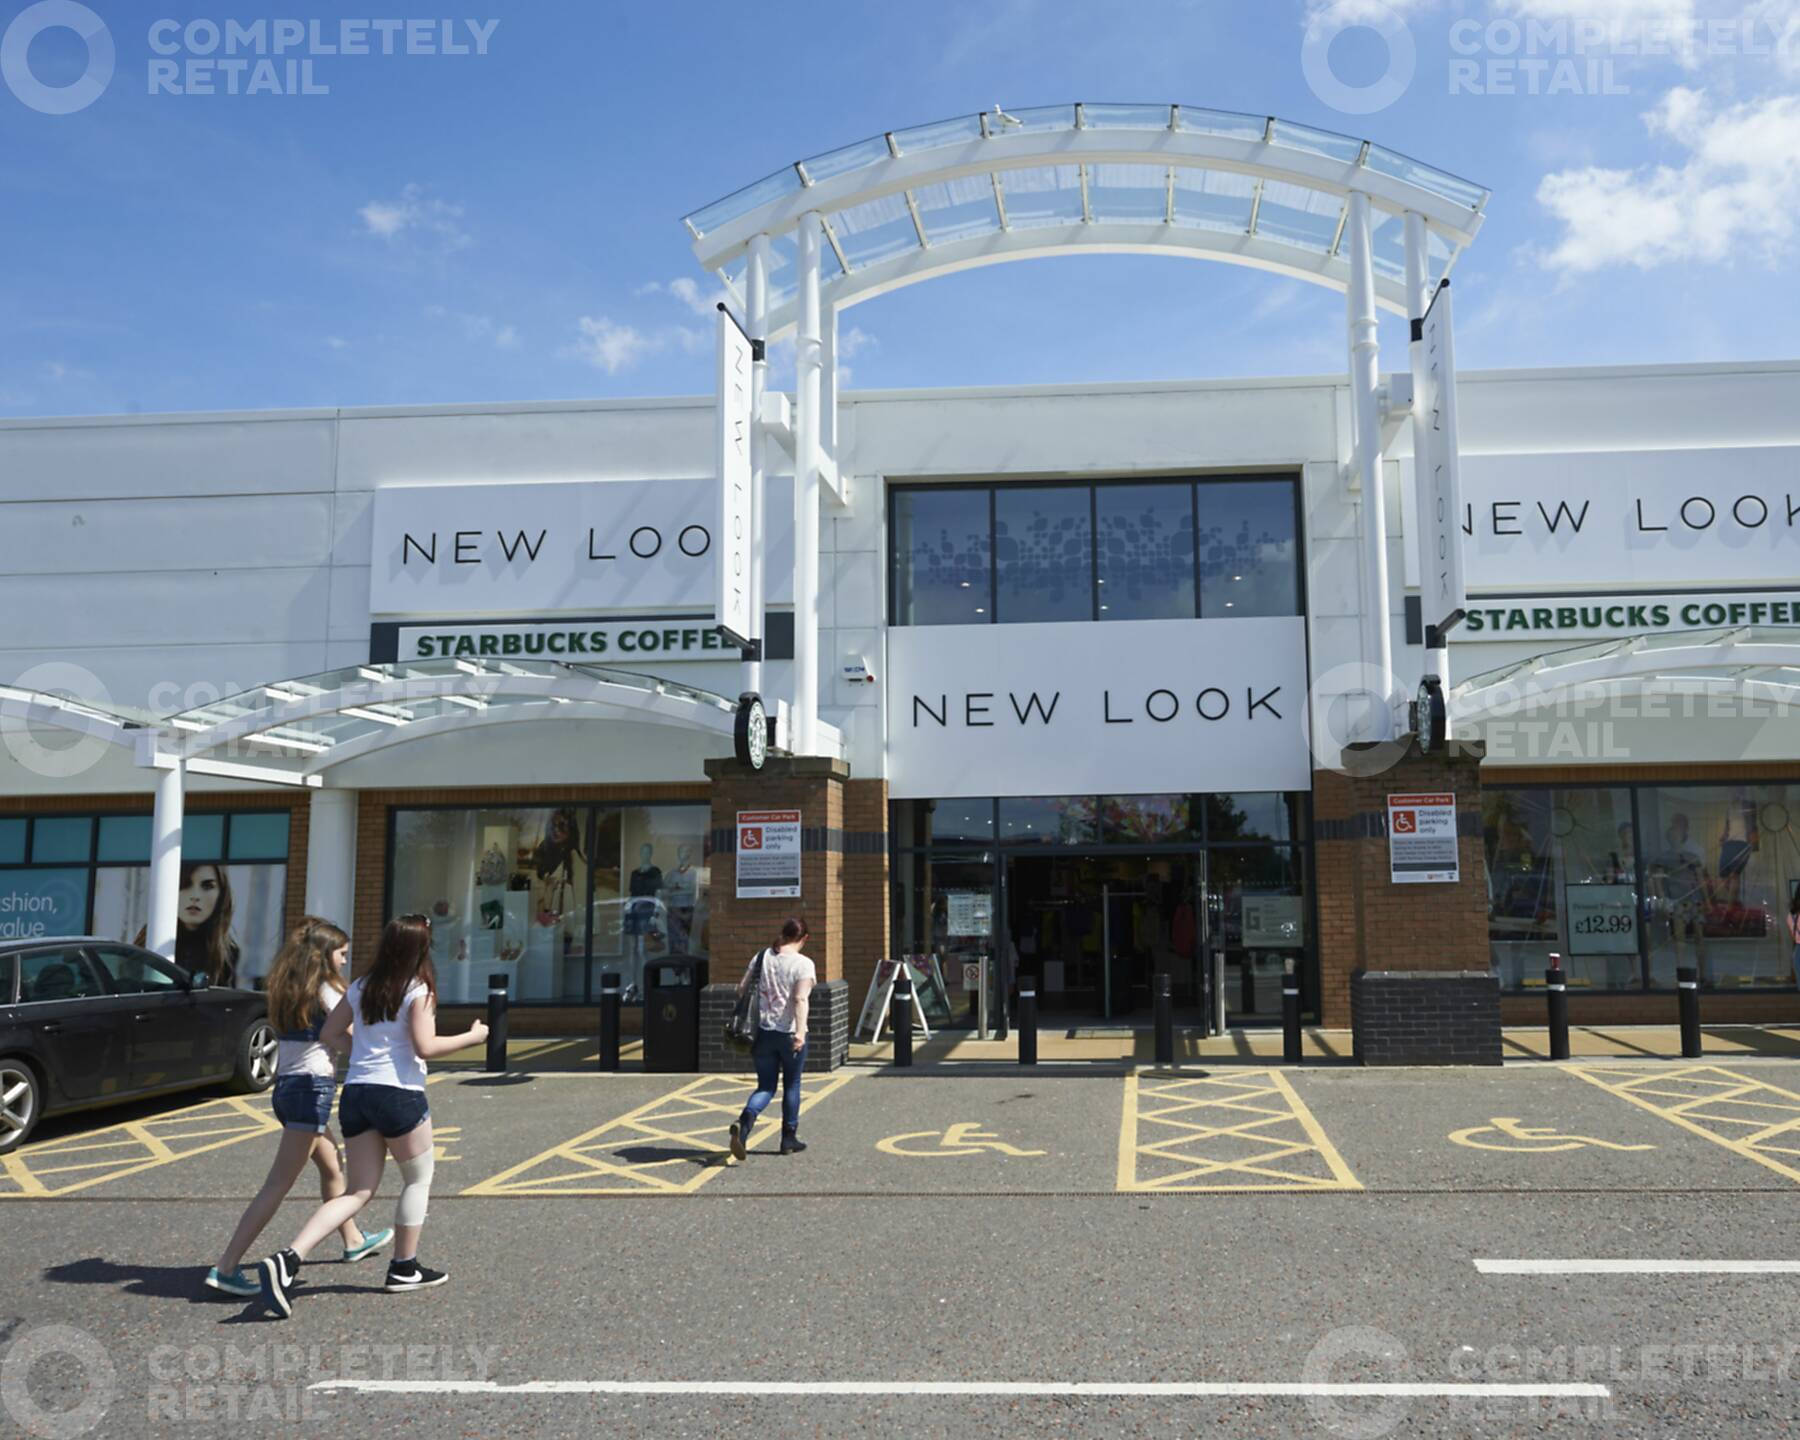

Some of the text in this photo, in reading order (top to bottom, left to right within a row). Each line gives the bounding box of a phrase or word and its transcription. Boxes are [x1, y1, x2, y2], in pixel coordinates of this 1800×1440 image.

[403, 525, 711, 564] NEW LOO
[1465, 604, 1670, 631] STARBUCKS
[416, 631, 608, 657] STARBUCKS
[912, 686, 1283, 727] NEW LOOK
[1419, 809, 1452, 817] Disabled
[1419, 818, 1448, 826] parking
[765, 834, 794, 842] parking
[1420, 827, 1436, 835] only
[0, 891, 58, 914] shion,
[0, 916, 45, 937] alue
[1575, 915, 1632, 934] £12.99
